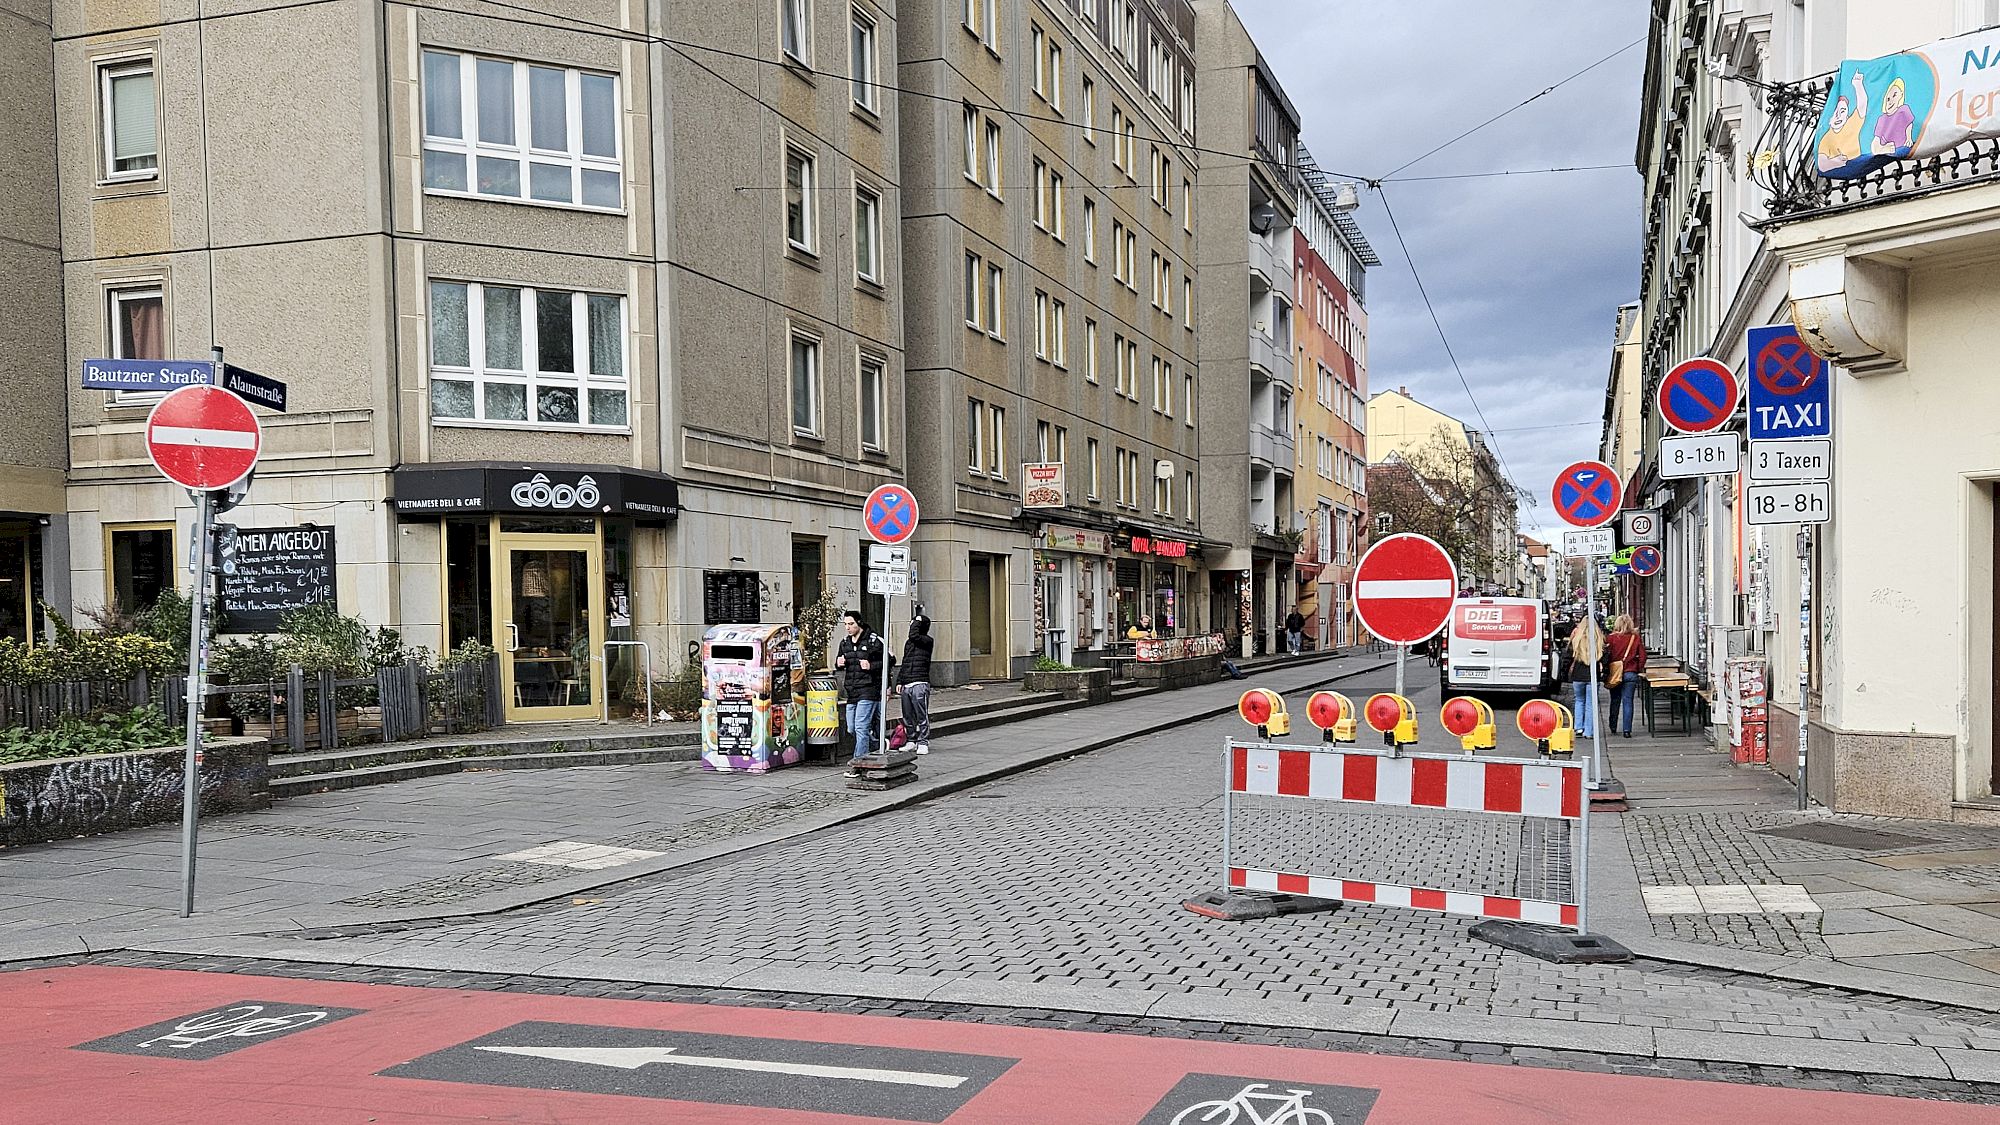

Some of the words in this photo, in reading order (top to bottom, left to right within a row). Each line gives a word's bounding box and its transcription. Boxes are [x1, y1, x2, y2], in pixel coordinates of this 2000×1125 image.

[88, 366, 155, 383] Bautzner
[159, 368, 208, 384] Straße
[229, 375, 284, 404] Alaunstraße
[1756, 402, 1822, 431] TAXI
[1759, 452, 1768, 469] 3
[1776, 452, 1821, 469] Taxen
[398, 499, 438, 509] VIETNAMESE
[439, 498, 455, 508] DELI
[456, 498, 463, 507] &
[625, 502, 652, 512] VIETNAMESE
[651, 504, 661, 513] DELI
[1635, 520, 1649, 530] 20
[235, 533, 267, 552] AMEN
[268, 531, 330, 551] ANGEBOT
[1131, 536, 1150, 554] ROYAL
[1568, 536, 1577, 544] ab
[1568, 545, 1577, 554] ab
[1595, 544, 1608, 552] Uhr
[312, 551, 325, 560] mit
[262, 583, 274, 593] mit
[1467, 610, 1499, 621] DHE
